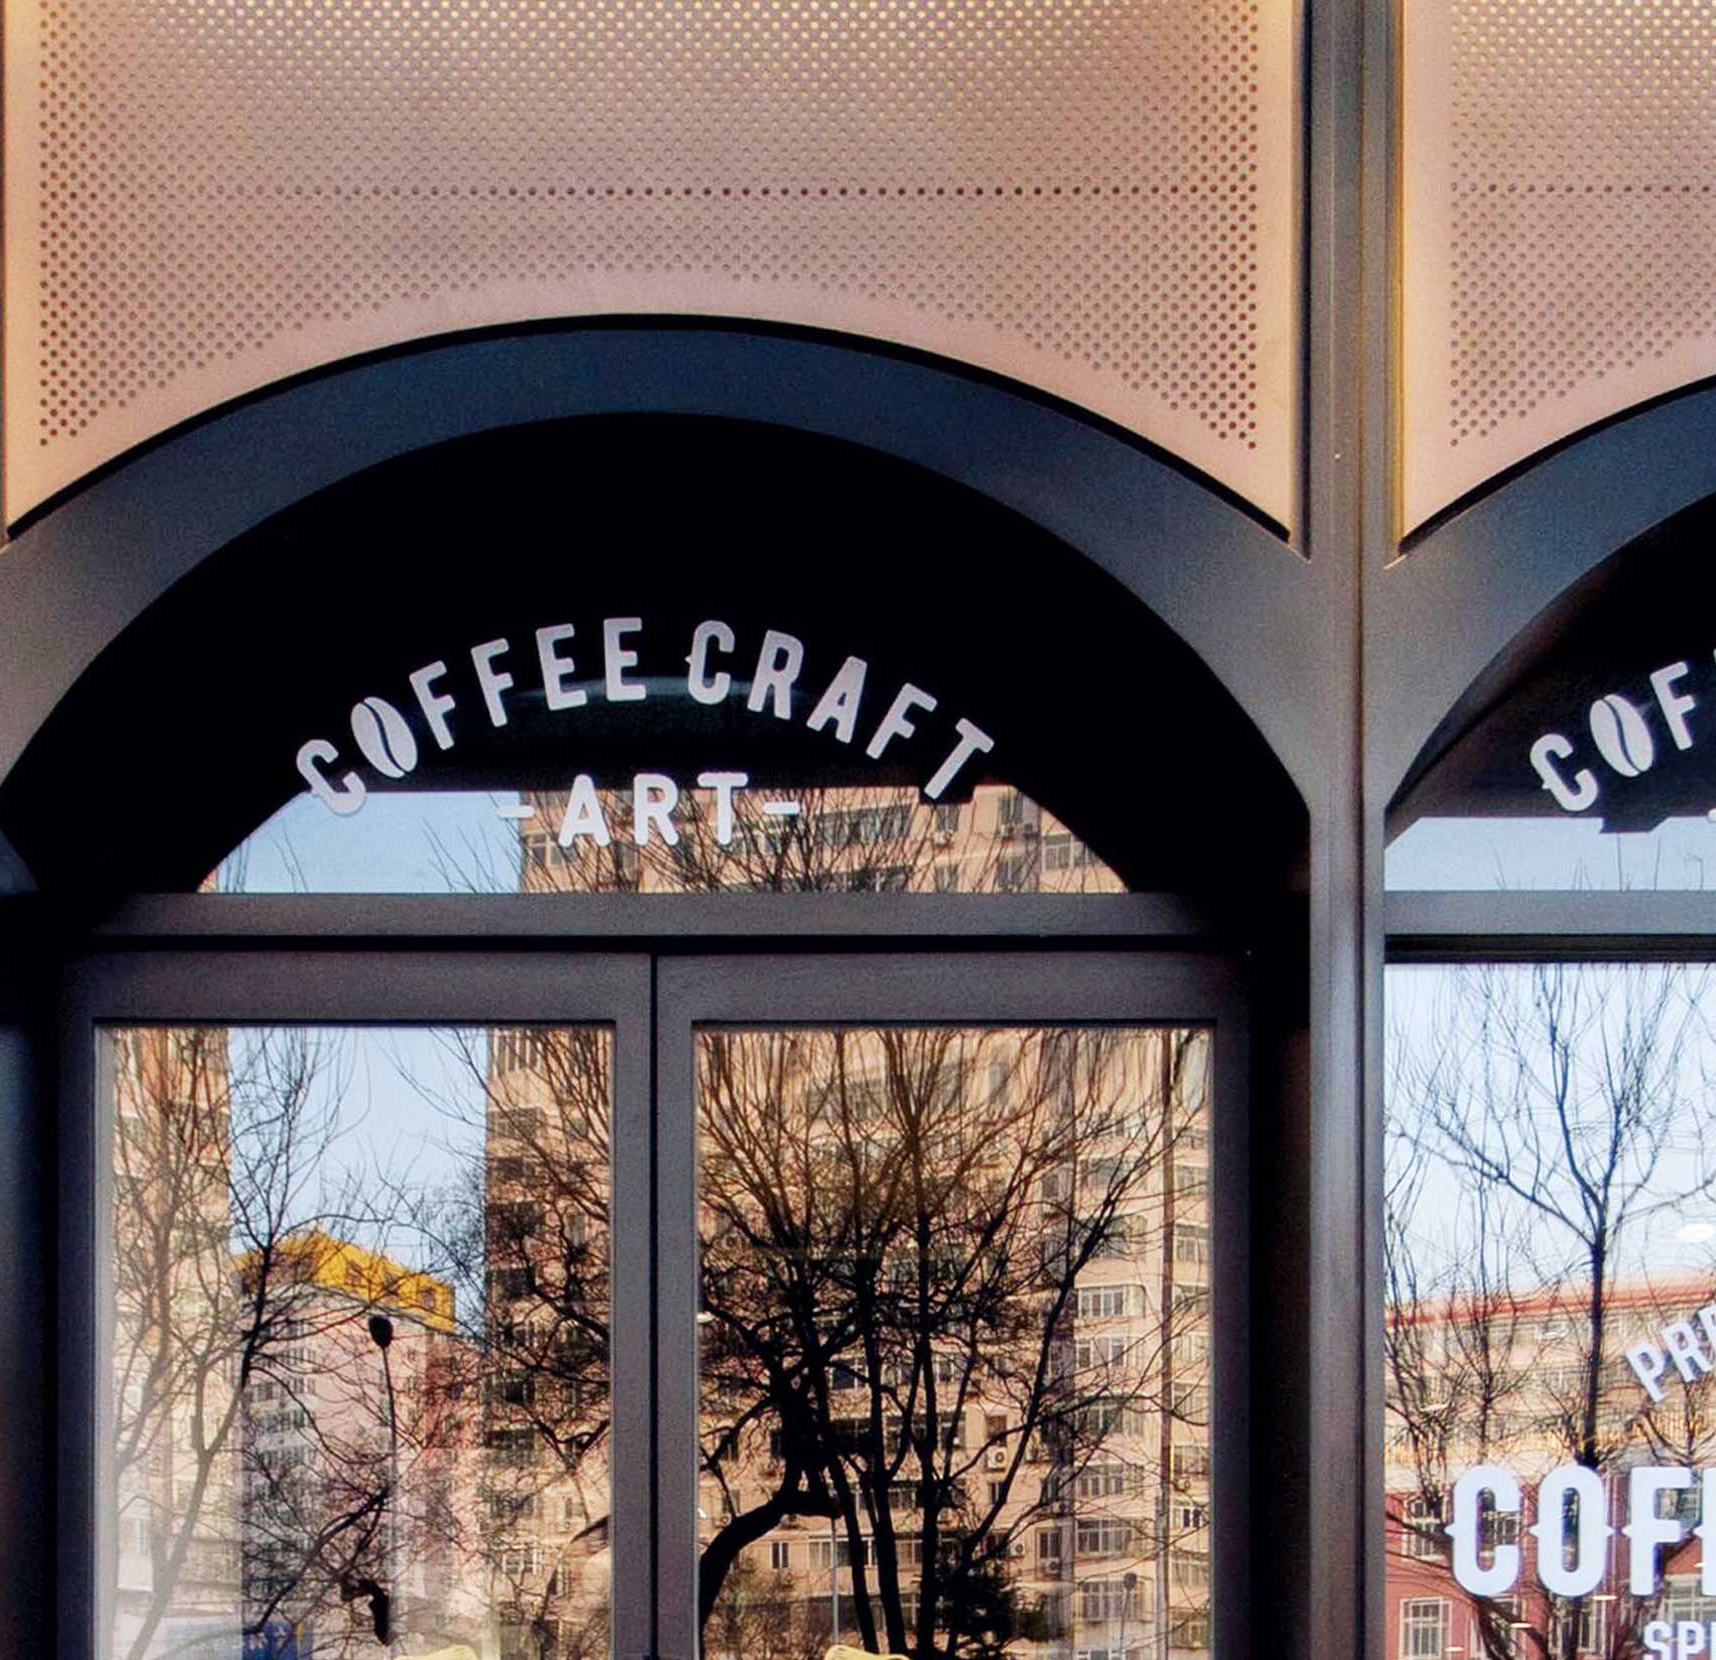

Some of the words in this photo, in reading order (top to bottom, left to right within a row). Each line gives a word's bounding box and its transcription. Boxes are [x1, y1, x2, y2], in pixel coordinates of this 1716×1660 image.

[295, 617, 647, 816] COFFEE
[685, 620, 994, 800] CRAFT
[558, 772, 749, 848] ART
